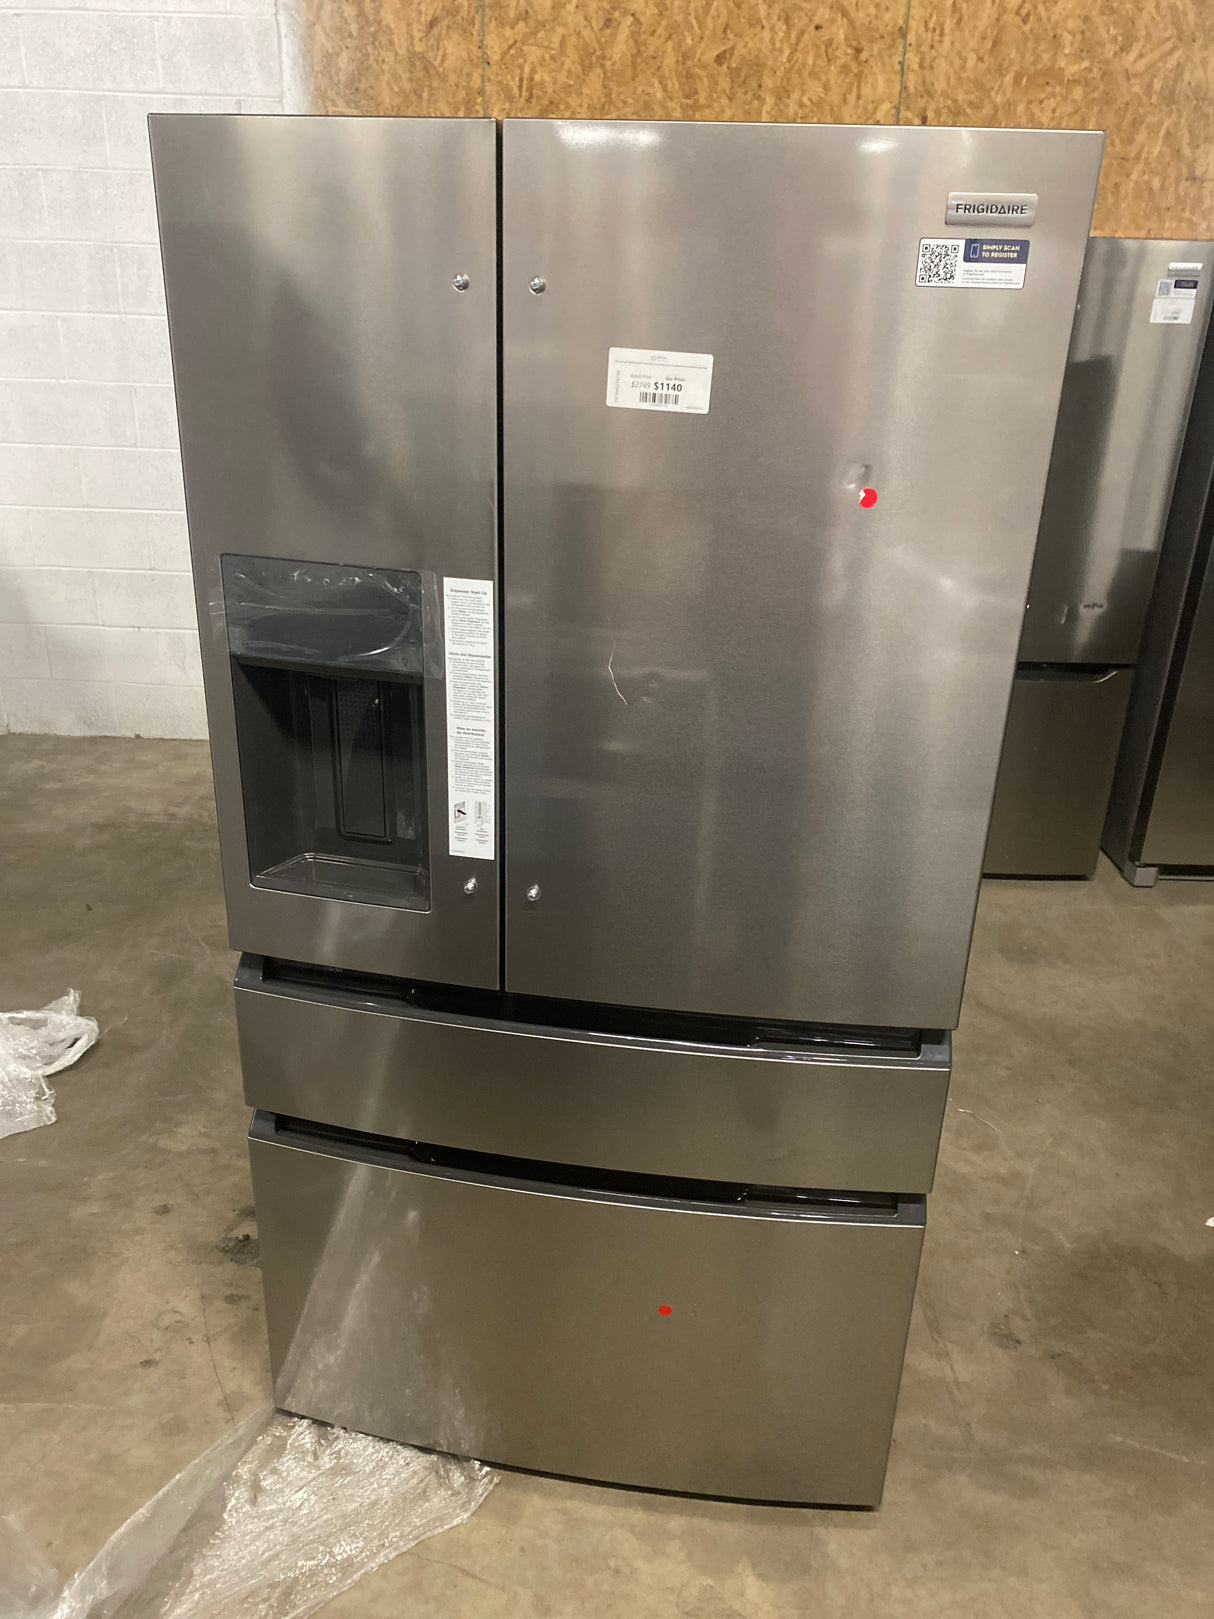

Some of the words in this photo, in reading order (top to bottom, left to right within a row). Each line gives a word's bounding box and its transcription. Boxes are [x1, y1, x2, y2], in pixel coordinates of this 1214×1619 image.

[955, 203, 1029, 215] FRIGIDAIRE
[631, 381, 651, 390] $2749
[654, 381, 683, 392] $1140
